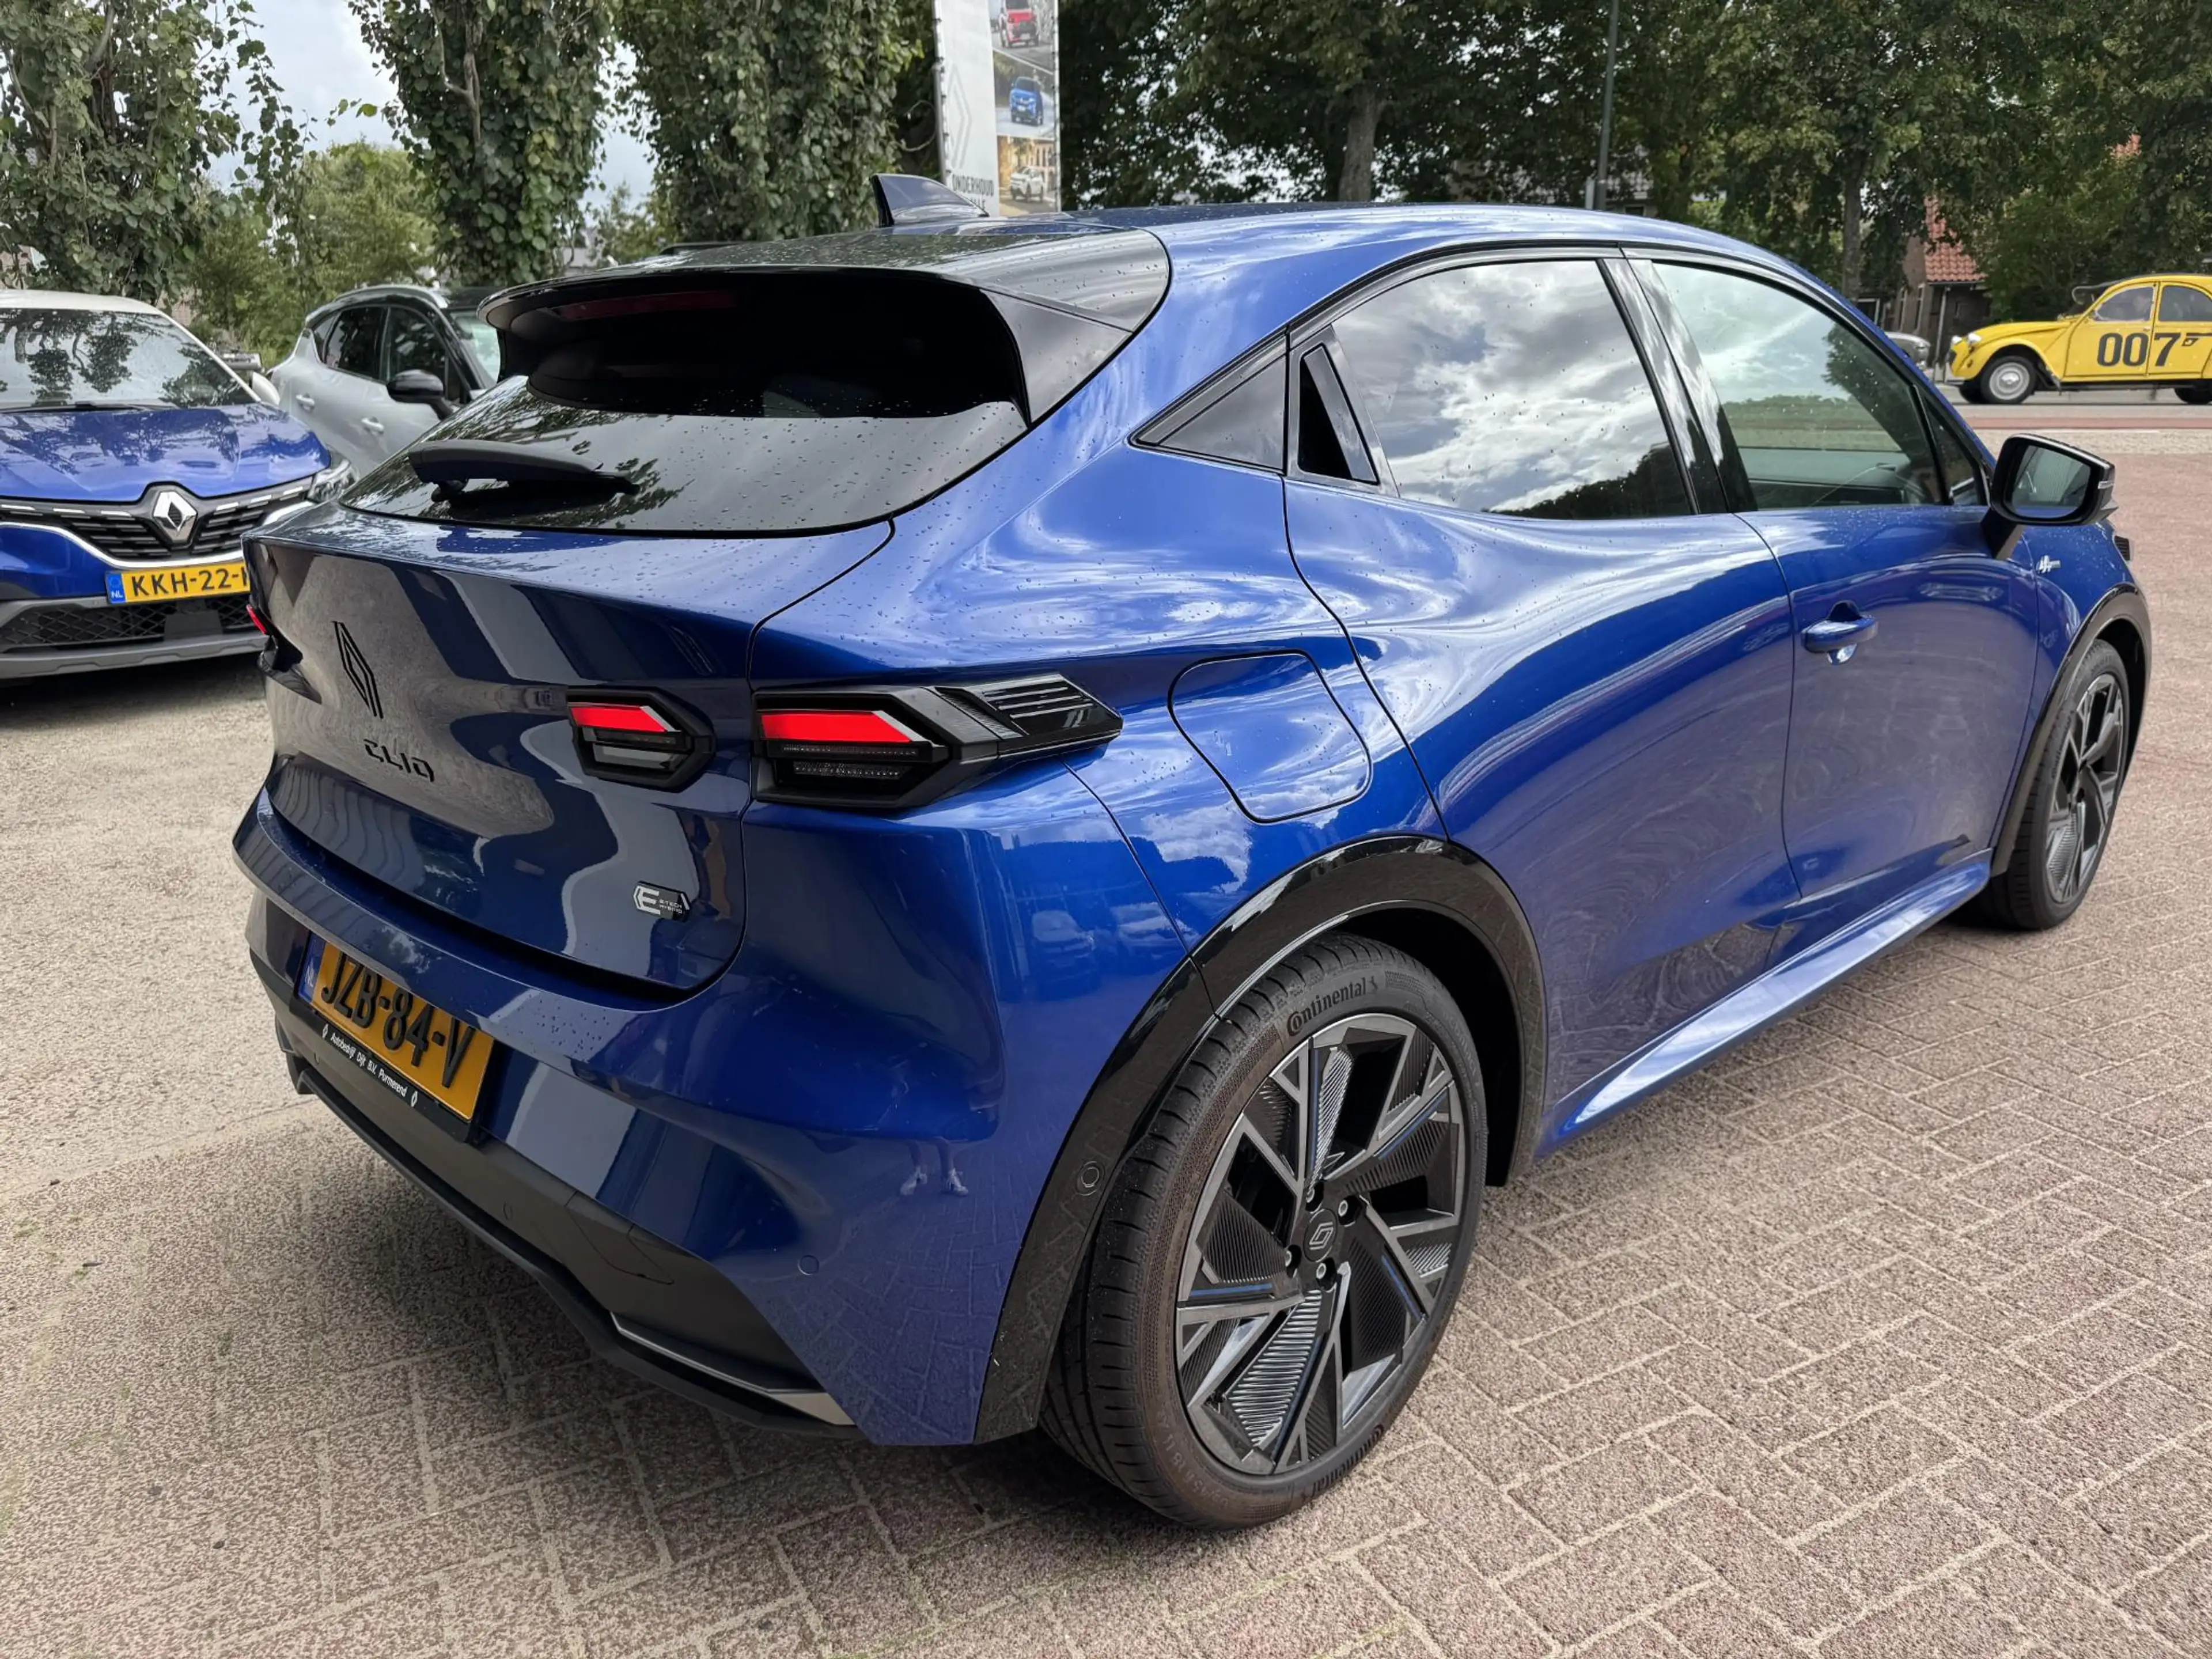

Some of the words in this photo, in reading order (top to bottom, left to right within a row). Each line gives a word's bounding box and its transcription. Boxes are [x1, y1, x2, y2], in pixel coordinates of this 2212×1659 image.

[2097, 332, 2181, 367] 007
[131, 567, 247, 597] KKH-22-
[363, 738, 435, 782] CLIO
[321, 950, 476, 1089] JZB-84-V
[1286, 976, 1366, 1037] Continental
